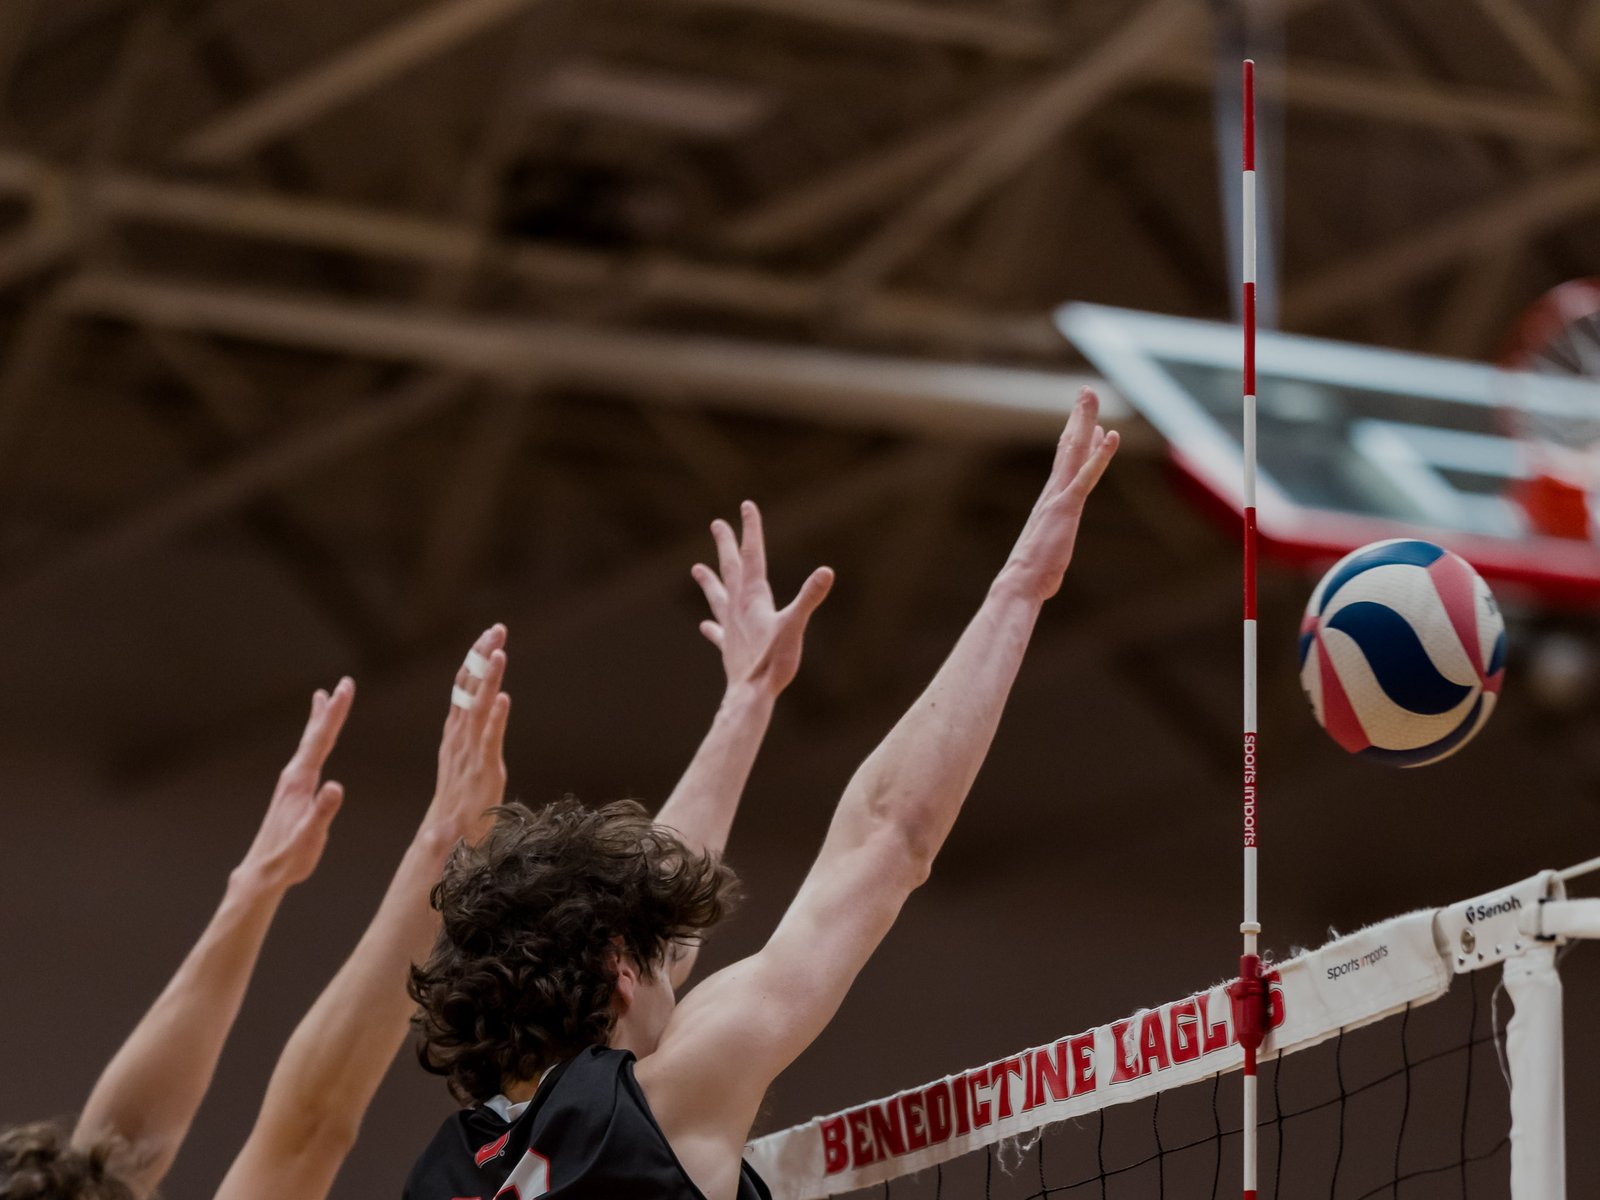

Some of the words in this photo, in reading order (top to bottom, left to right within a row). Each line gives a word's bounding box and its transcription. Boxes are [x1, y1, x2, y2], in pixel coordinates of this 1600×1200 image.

[1244, 734, 1257, 783] sports
[1244, 787, 1257, 847] imports
[1476, 895, 1522, 921] Senoh
[1326, 959, 1360, 981] sports
[820, 1030, 1097, 1175] BENEDICTINE
